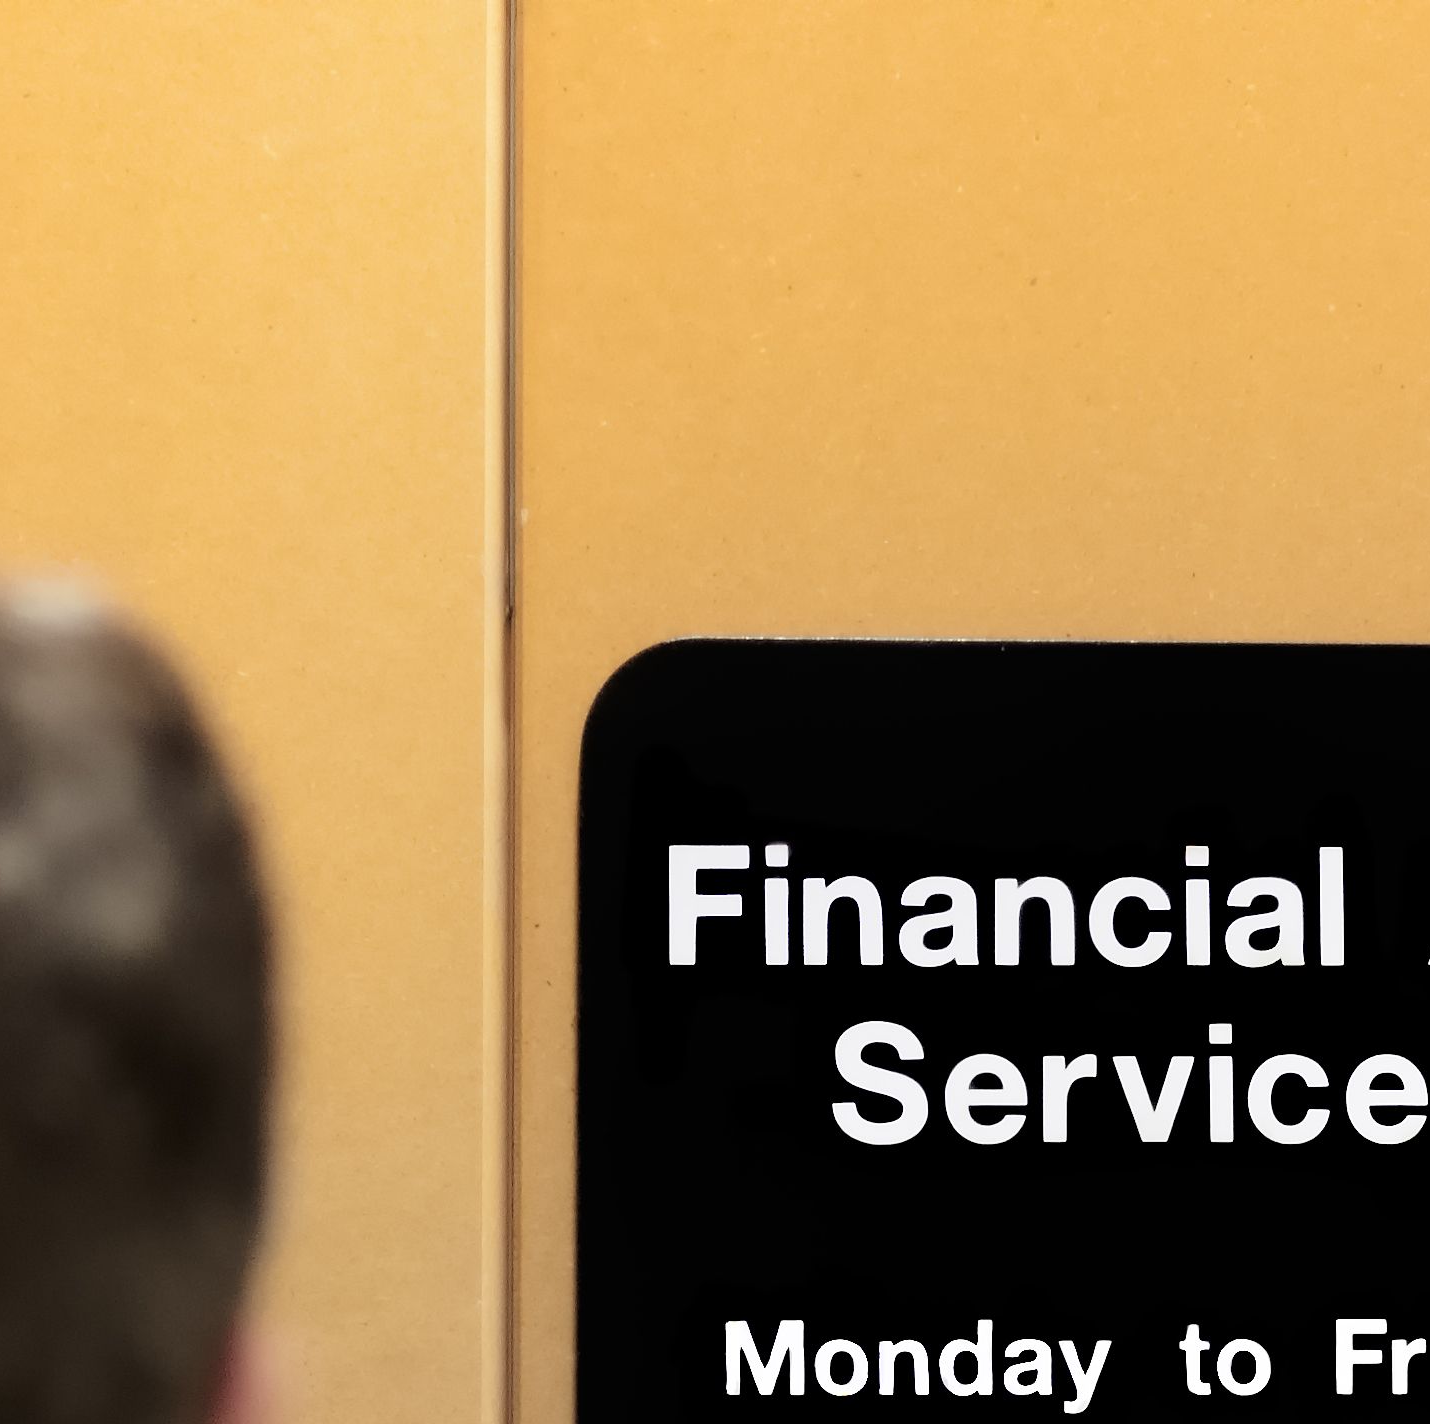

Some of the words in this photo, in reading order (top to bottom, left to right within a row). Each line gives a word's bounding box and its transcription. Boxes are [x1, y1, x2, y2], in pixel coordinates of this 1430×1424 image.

[667, 843, 1346, 969] Financial
[723, 1318, 1114, 1416] Monday
[1177, 1322, 1273, 1398] to
